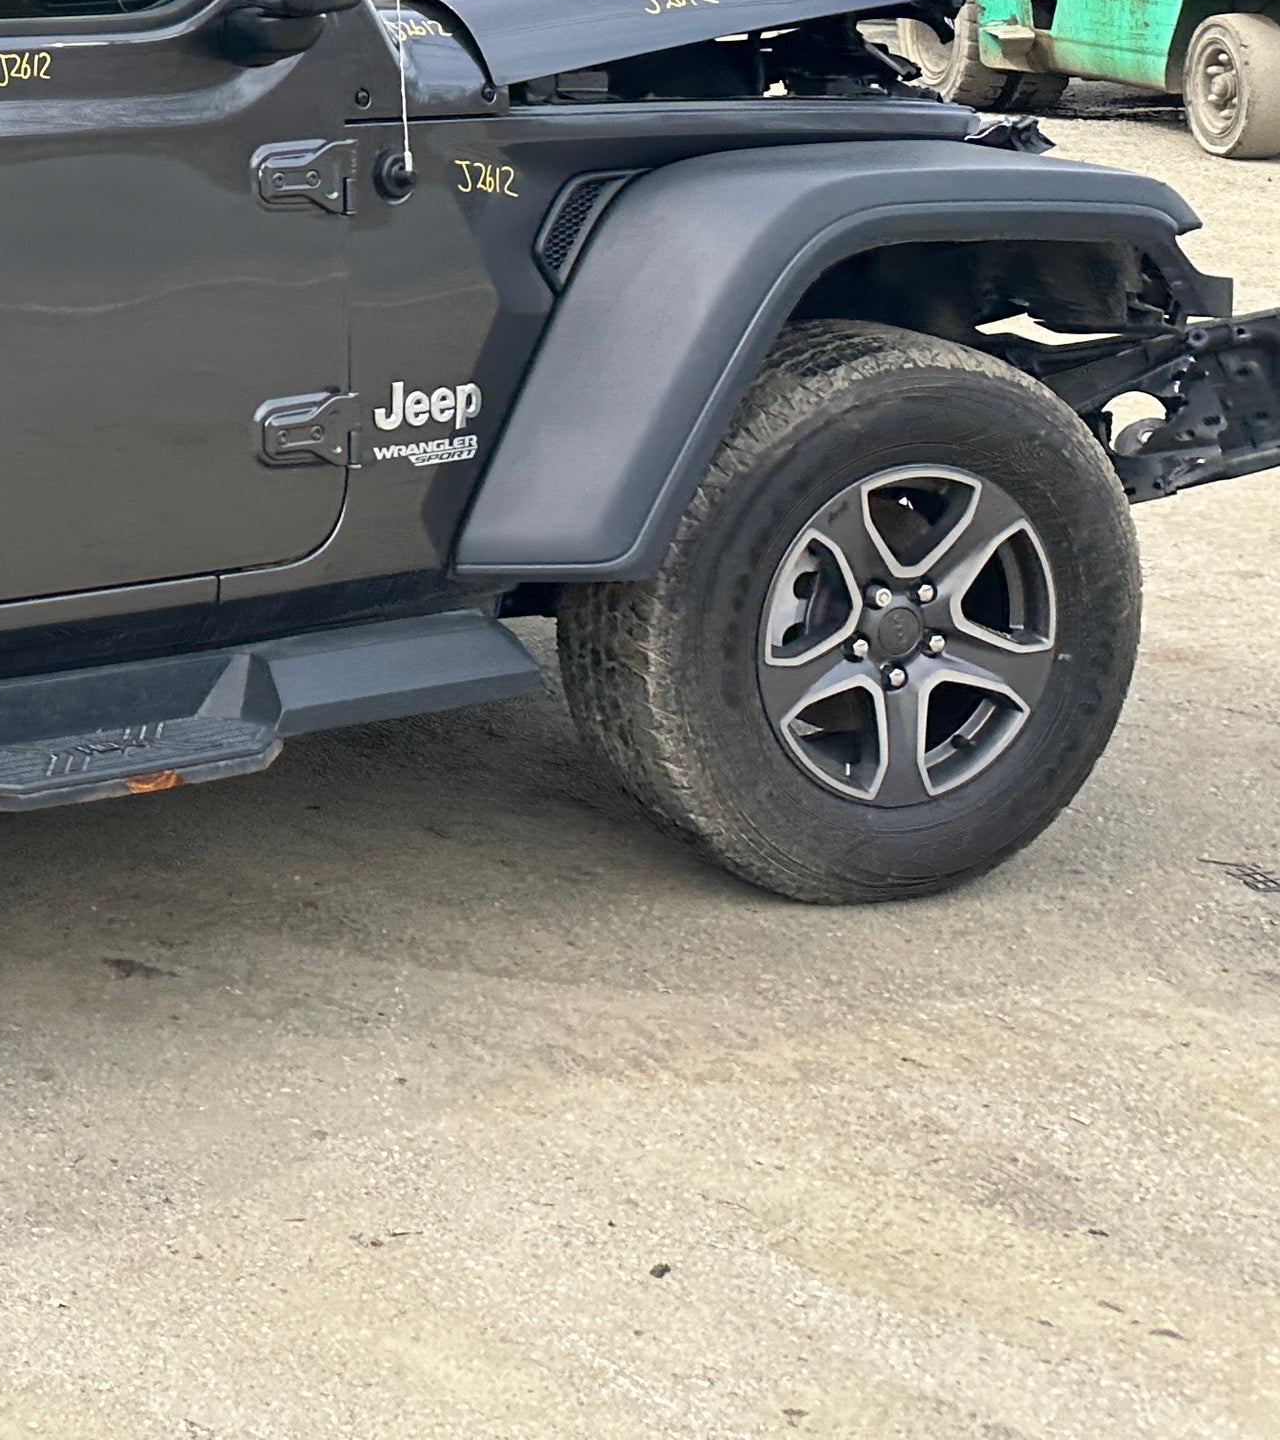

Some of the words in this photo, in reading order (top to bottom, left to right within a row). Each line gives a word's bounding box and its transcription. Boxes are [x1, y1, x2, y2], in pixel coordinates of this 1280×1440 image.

[454, 159, 519, 198] J2612
[374, 381, 482, 430] Jeep
[373, 434, 478, 461] WRANGLER
[410, 448, 476, 465] SPORT
